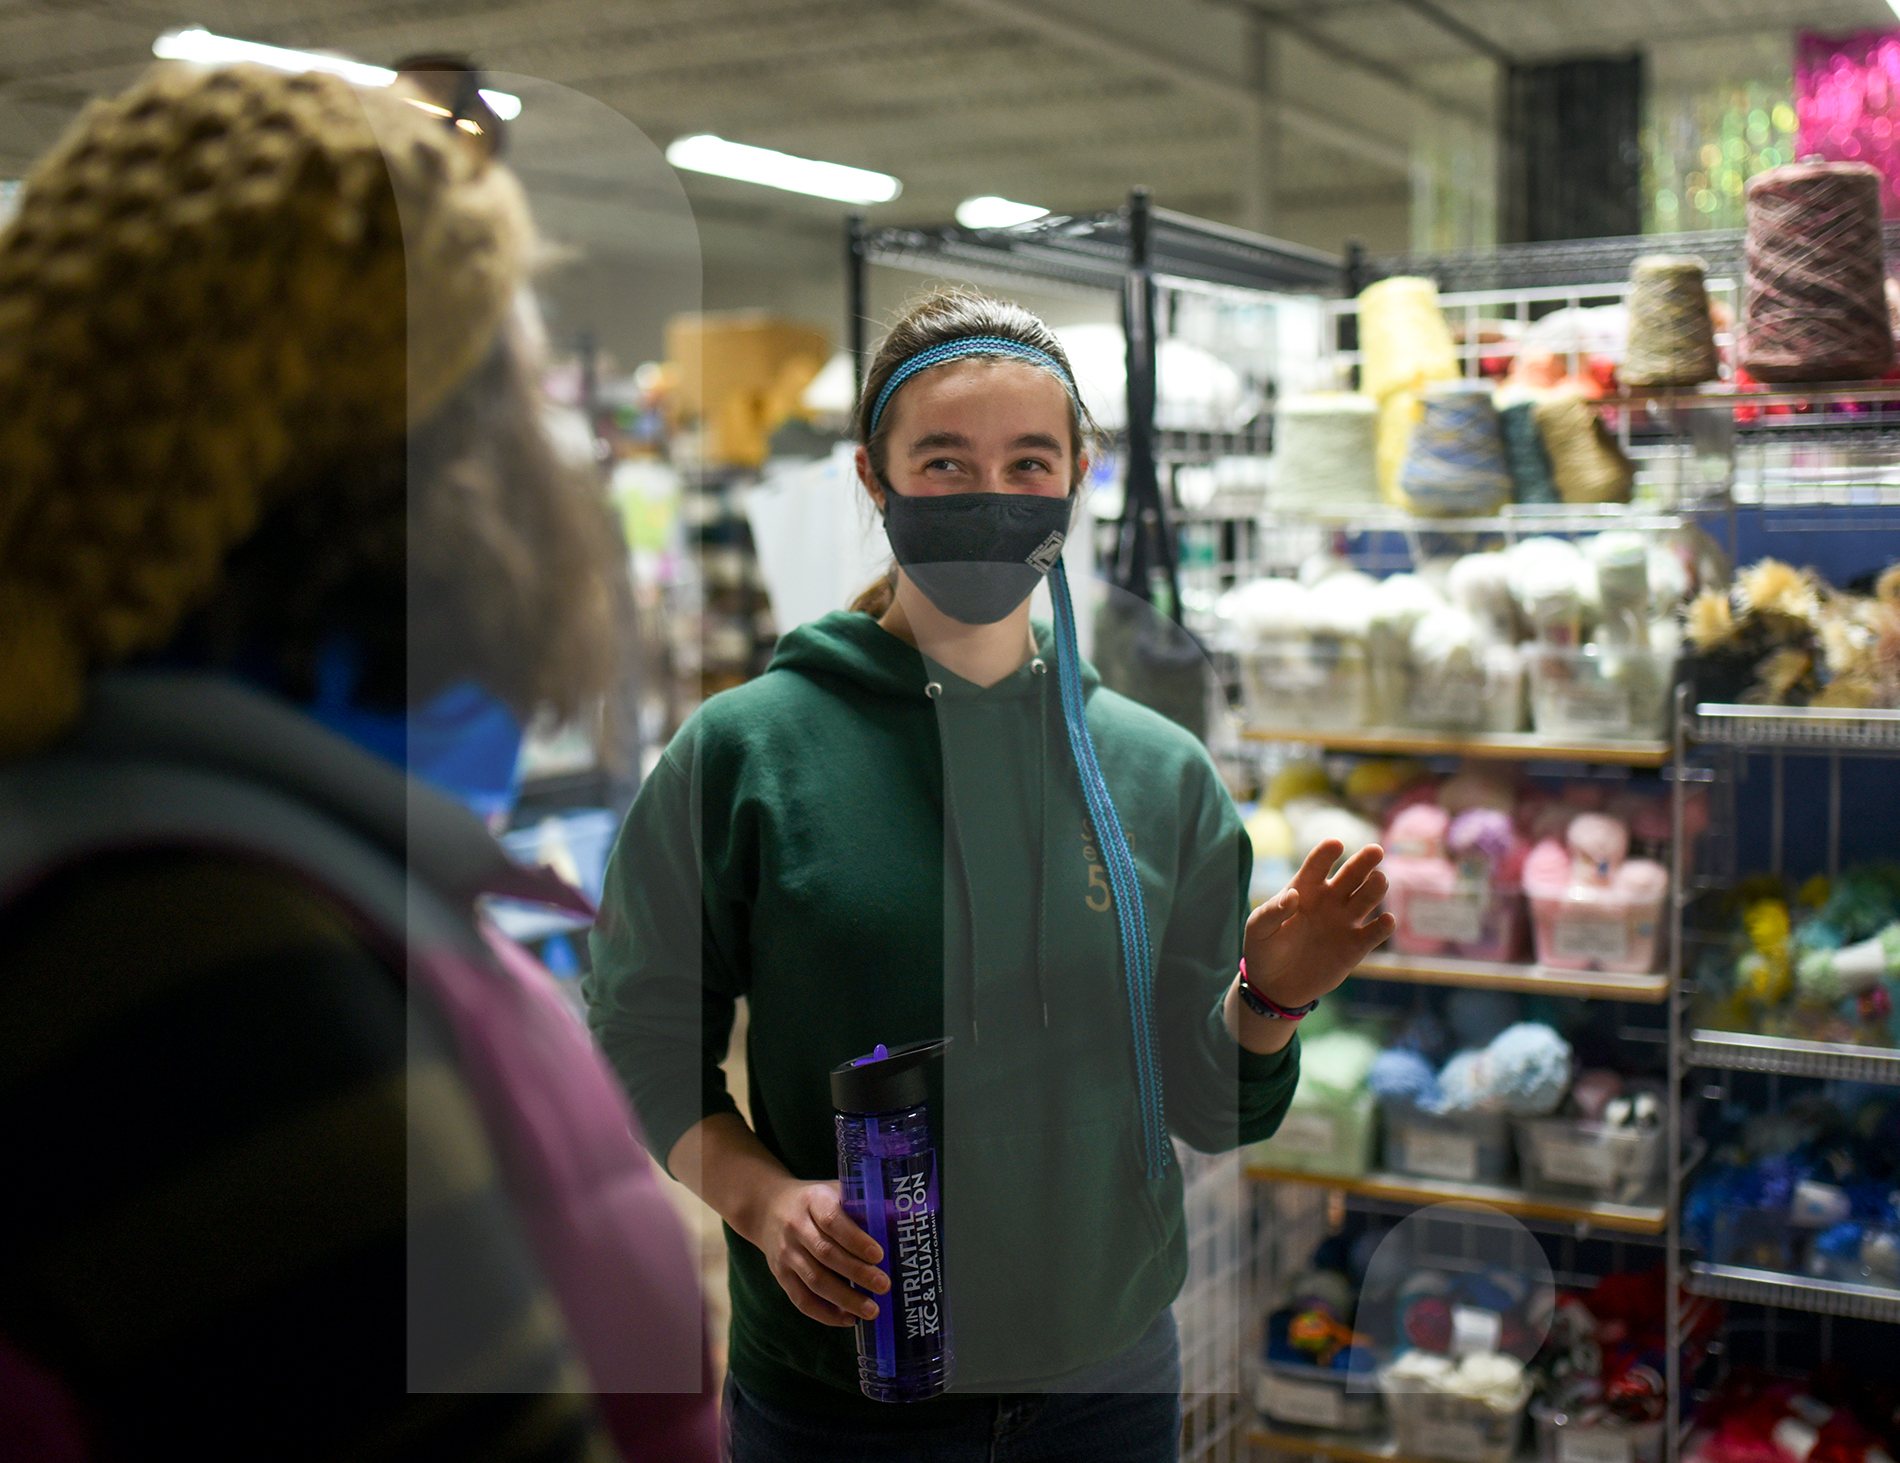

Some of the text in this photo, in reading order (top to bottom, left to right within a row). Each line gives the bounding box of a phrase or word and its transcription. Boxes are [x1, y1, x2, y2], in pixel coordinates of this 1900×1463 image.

[892, 1175, 921, 1339] WIN TRIATHLON
[911, 1171, 940, 1334] KC & DUATHLON
